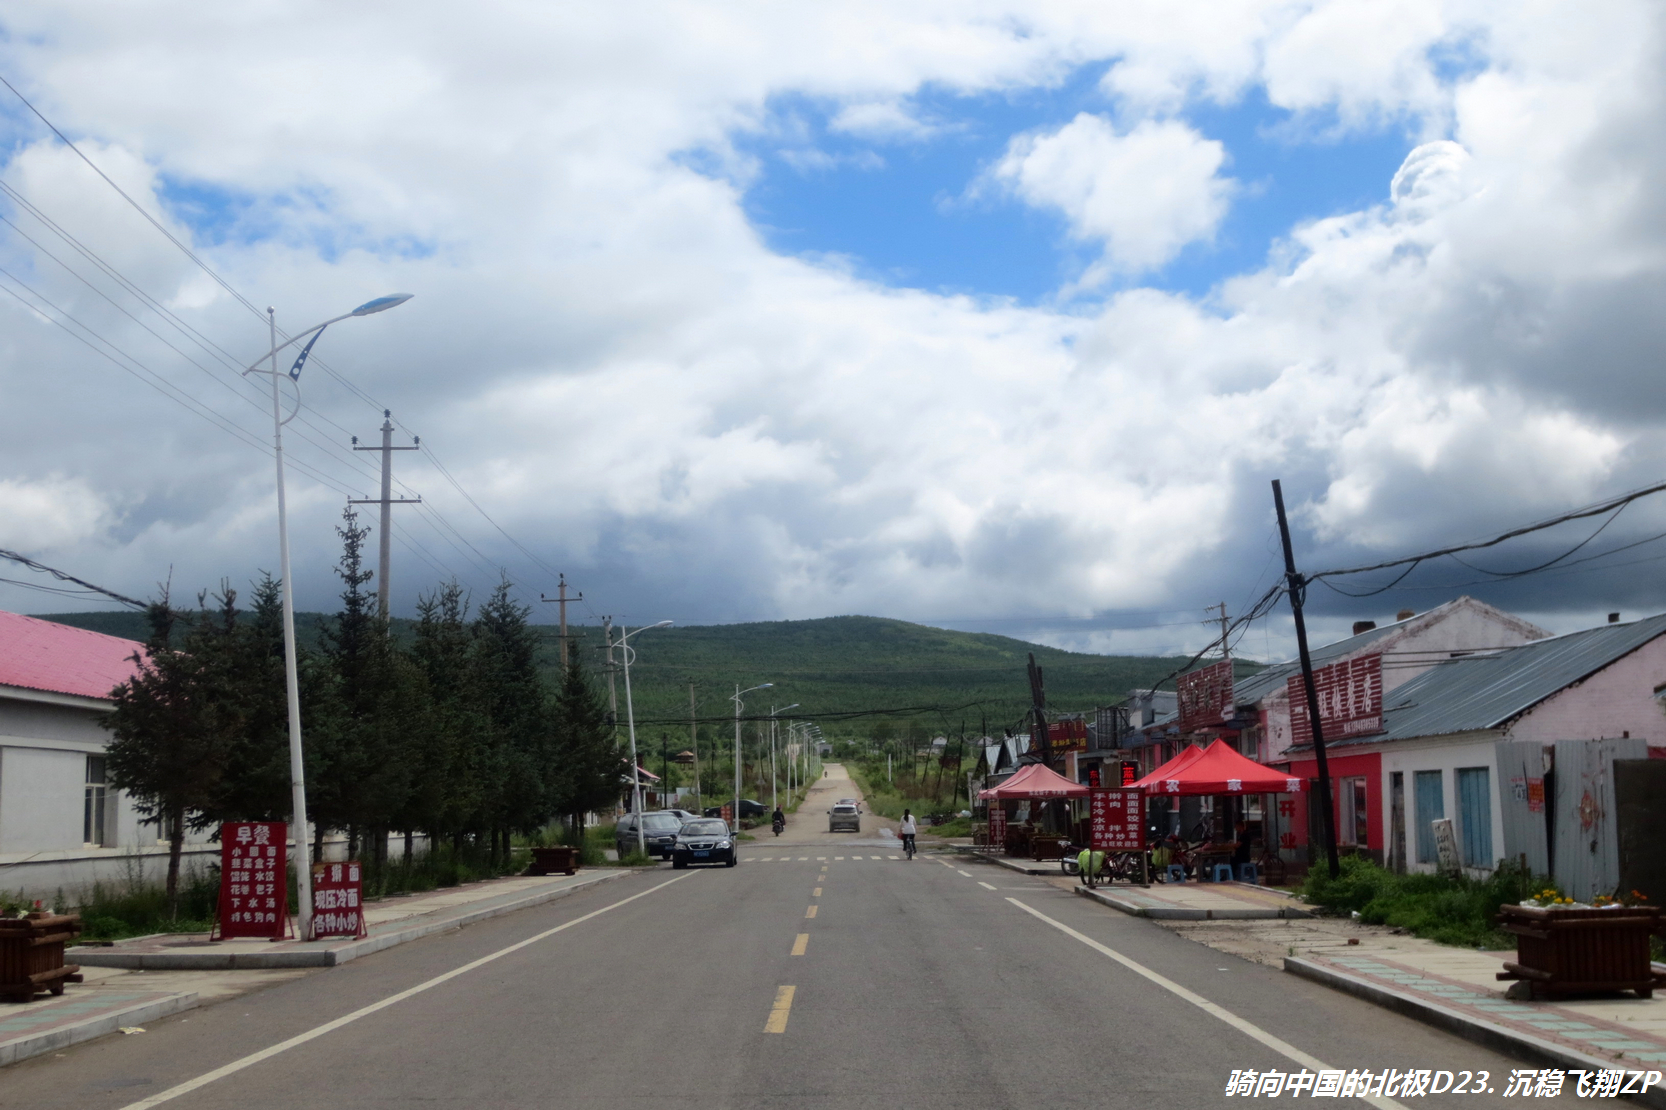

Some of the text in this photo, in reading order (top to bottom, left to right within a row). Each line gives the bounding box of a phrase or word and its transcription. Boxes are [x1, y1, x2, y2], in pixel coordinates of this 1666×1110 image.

[1092, 800, 1139, 808] 牛肉面
[1092, 823, 1139, 832] 凉拌菜
[1279, 800, 1297, 849] 开业
[236, 825, 270, 846] 早餐
[1094, 831, 1138, 840] 各种炒菜
[231, 858, 276, 869] 韭菜盒子
[231, 897, 276, 909] 下水汤
[315, 888, 358, 909] 现压冷面
[231, 911, 276, 923] 特色狗肉
[314, 911, 358, 933] 各种小炒
